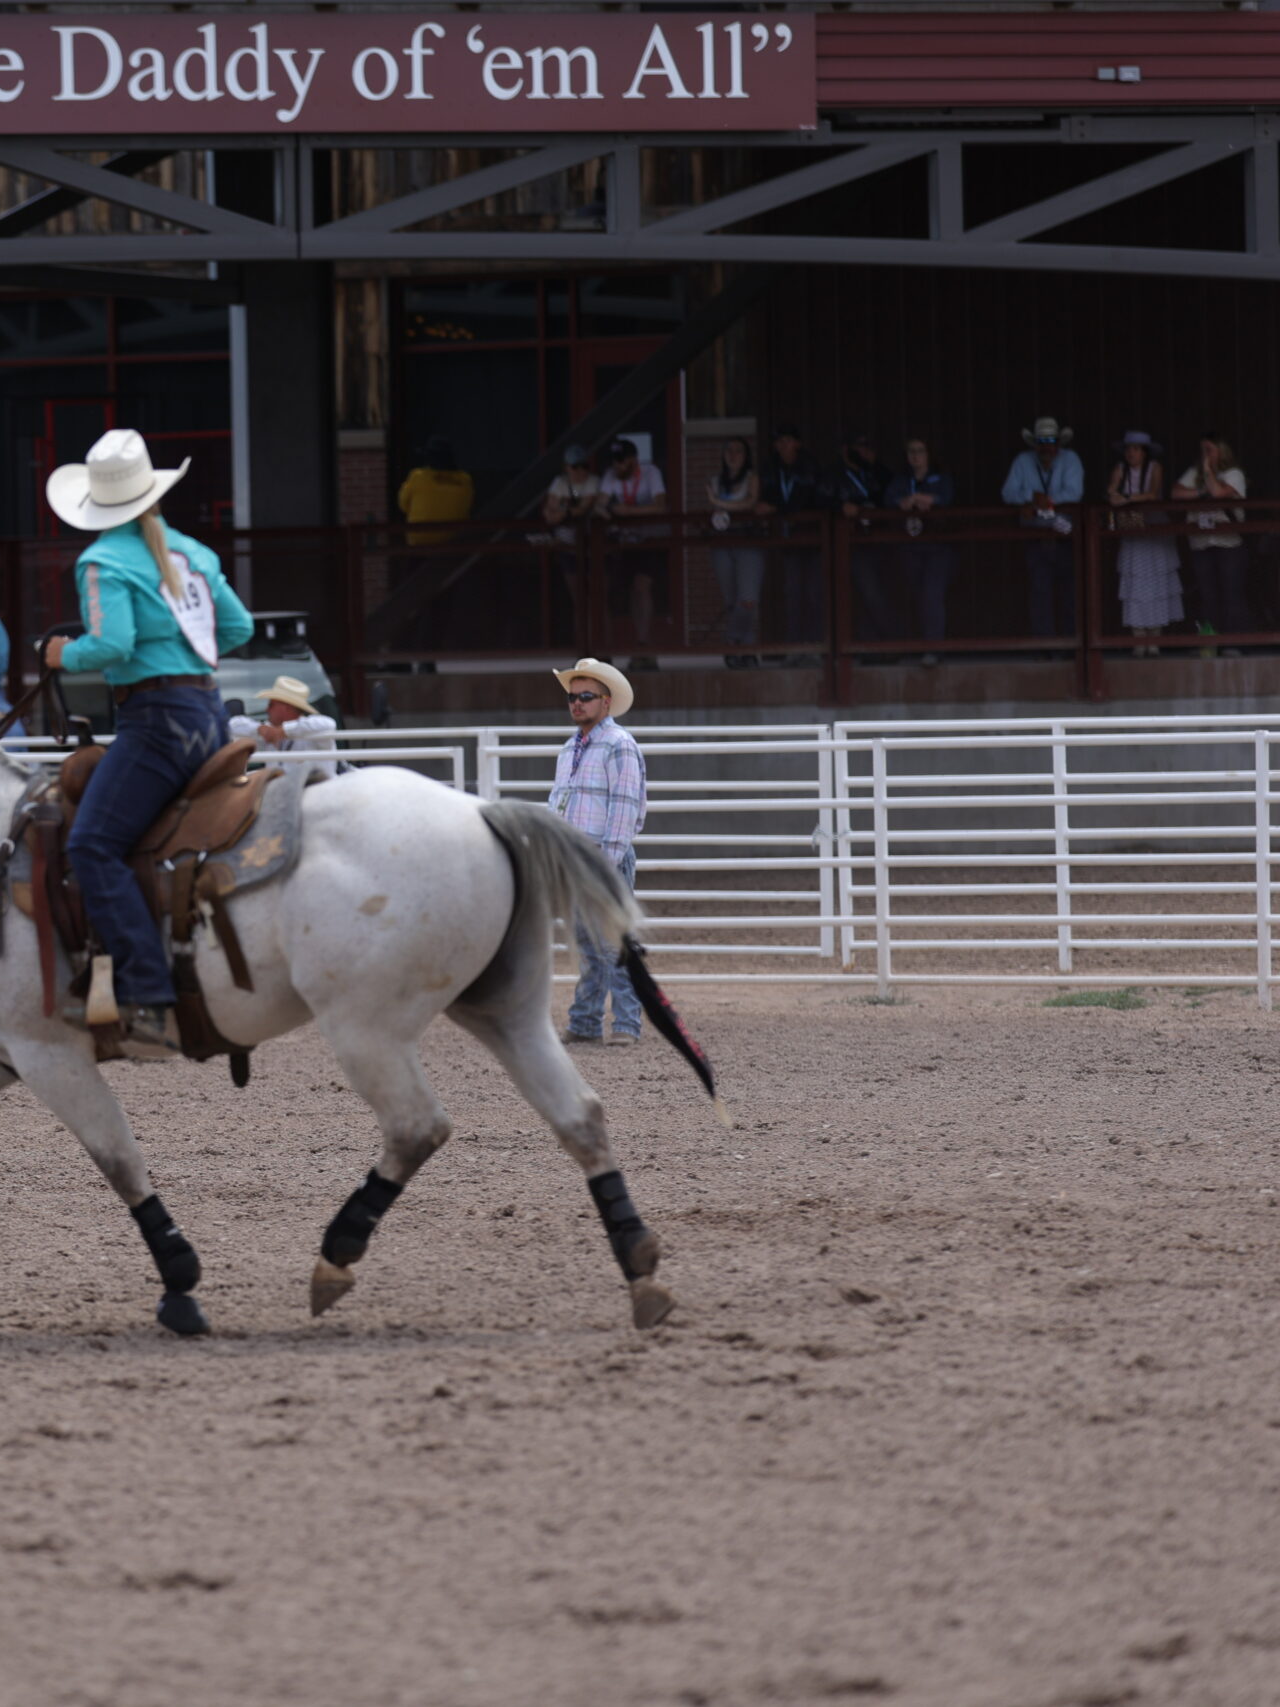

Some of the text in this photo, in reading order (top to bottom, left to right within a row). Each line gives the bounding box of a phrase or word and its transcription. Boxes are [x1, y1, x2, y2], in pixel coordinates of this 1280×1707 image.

[51, 22, 326, 123] Daddy
[352, 22, 446, 100] of
[466, 24, 604, 100] ‘em
[622, 21, 793, 99] All”
